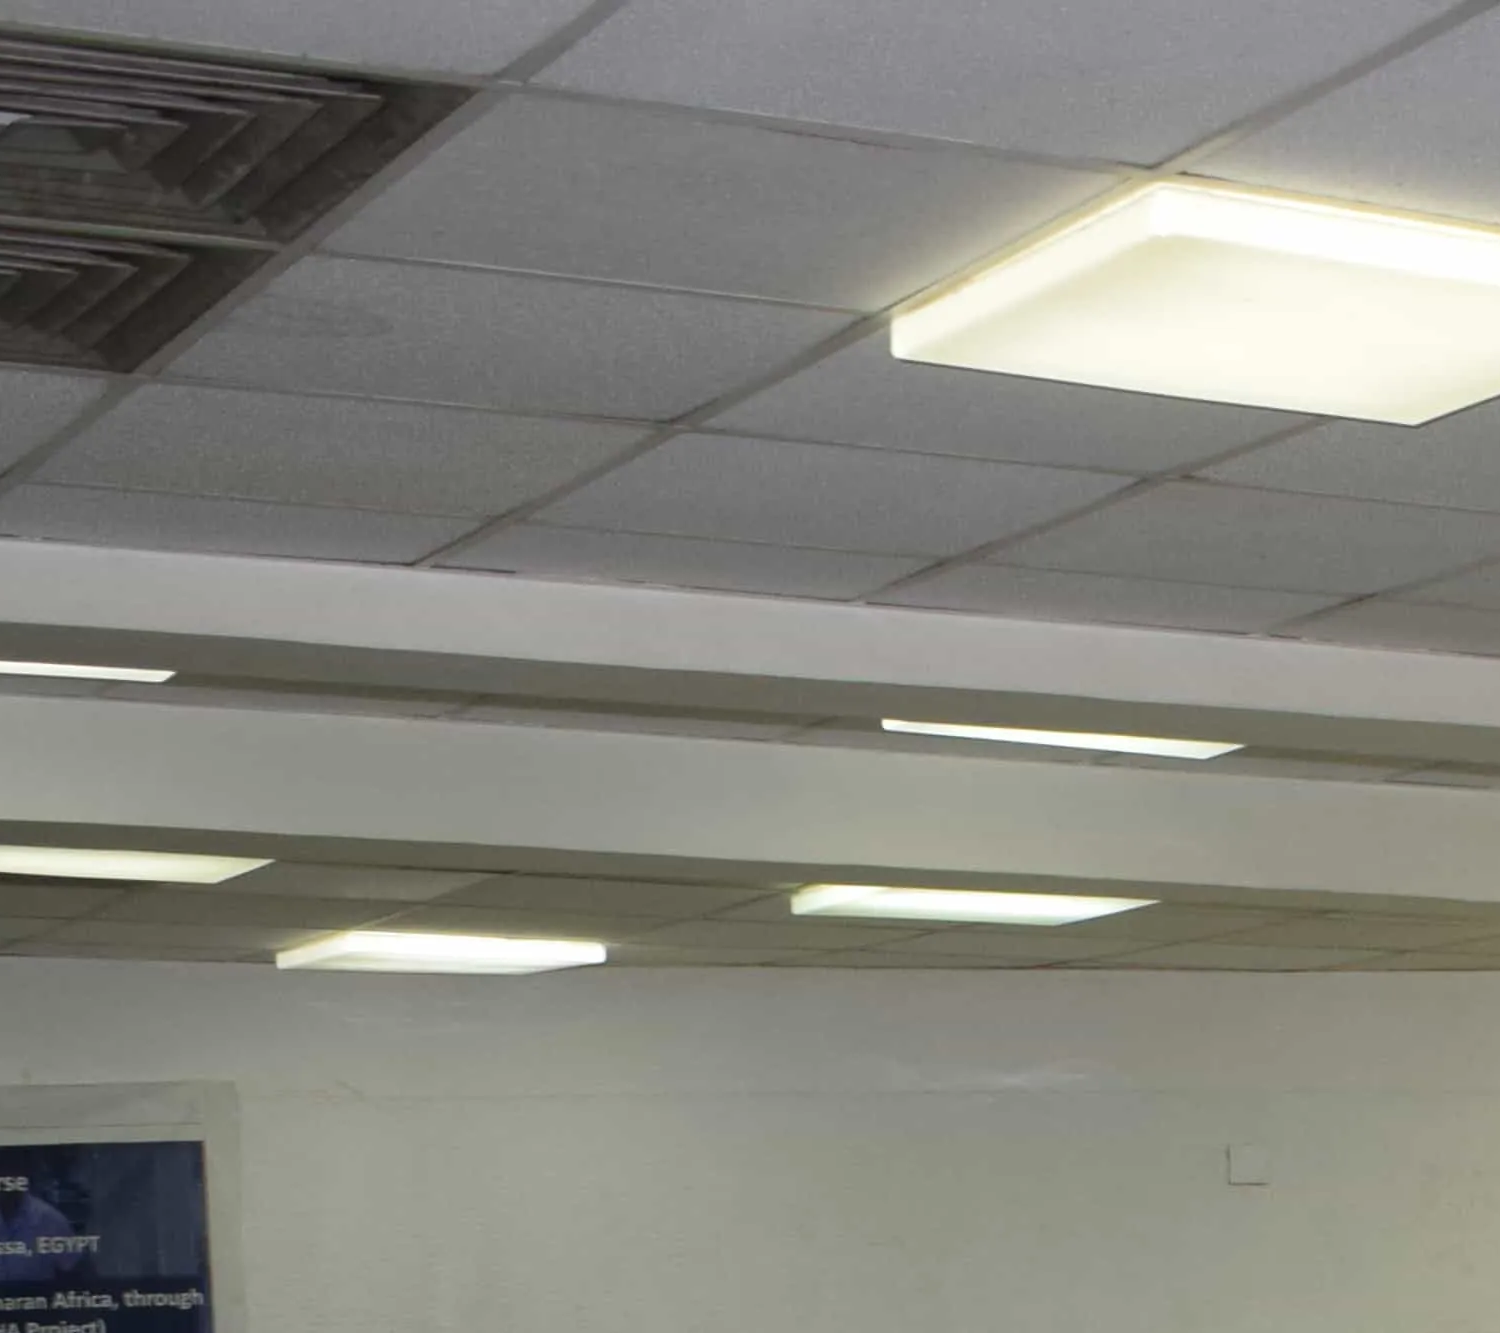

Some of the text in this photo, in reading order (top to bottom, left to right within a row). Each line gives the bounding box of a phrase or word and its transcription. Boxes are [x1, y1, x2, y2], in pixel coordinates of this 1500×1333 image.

[36, 1234, 101, 1255] EGYPT
[52, 1292, 120, 1313] Africa,
[123, 1288, 205, 1311] through
